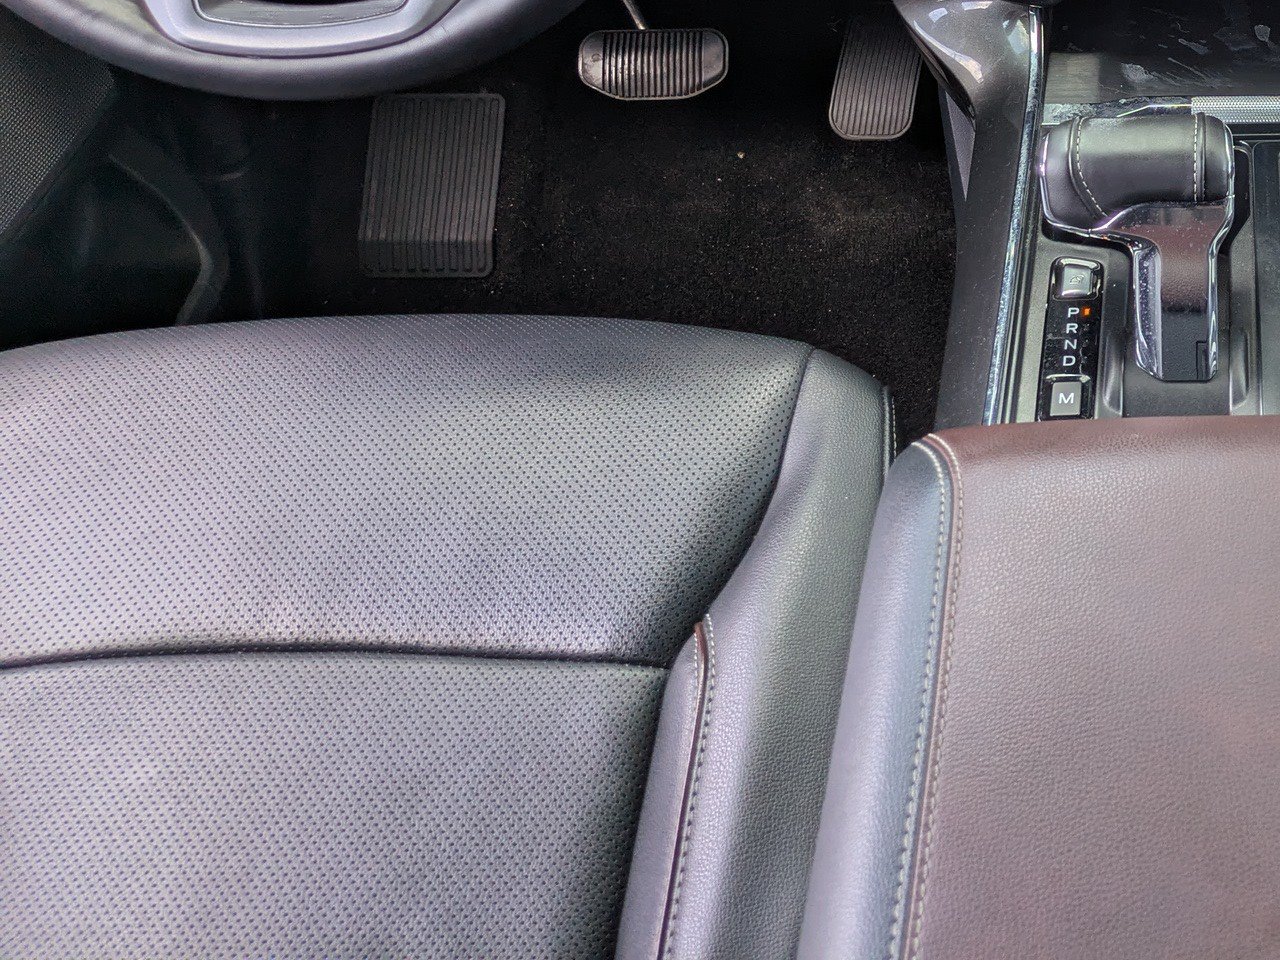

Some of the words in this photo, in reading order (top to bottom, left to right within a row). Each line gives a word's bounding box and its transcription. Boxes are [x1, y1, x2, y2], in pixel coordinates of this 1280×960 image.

[1067, 307, 1080, 318] P
[1066, 323, 1078, 334] R
[1064, 339, 1077, 350] N
[1062, 356, 1076, 366] D
[1058, 393, 1075, 404] M
